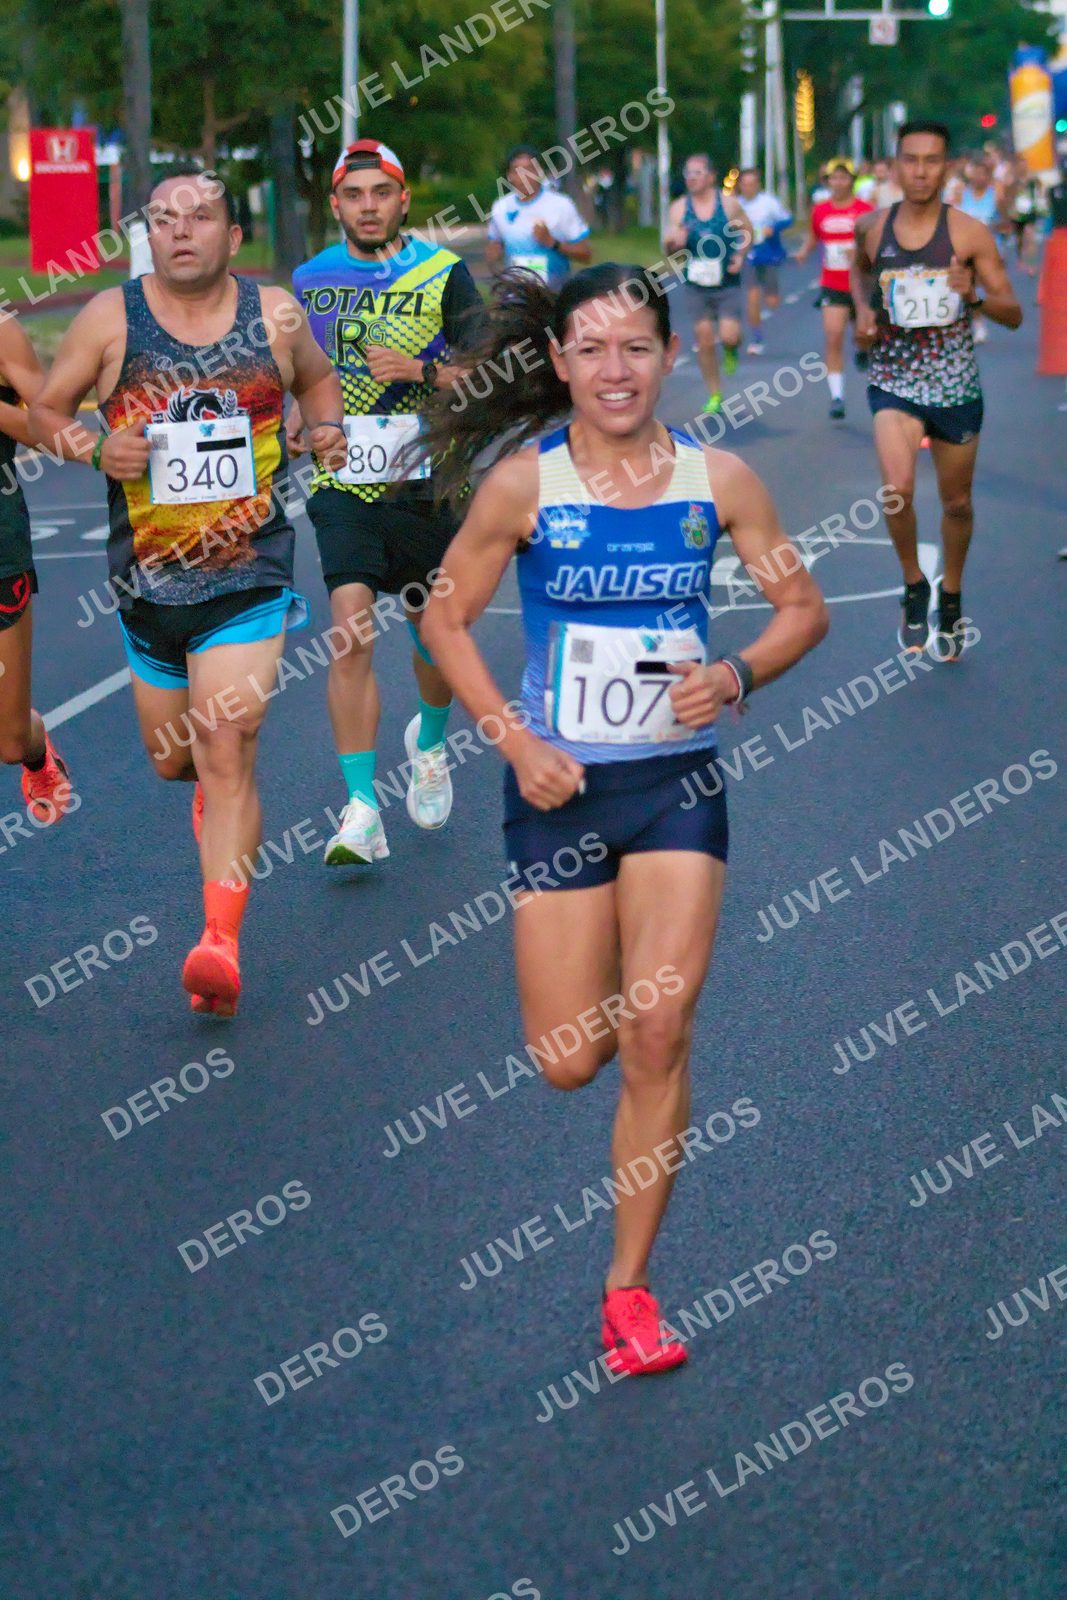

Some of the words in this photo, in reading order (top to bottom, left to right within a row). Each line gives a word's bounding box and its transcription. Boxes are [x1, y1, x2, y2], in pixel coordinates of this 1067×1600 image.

[903, 297, 950, 320] 215
[167, 454, 239, 493] 340
[574, 676, 682, 728] 107
